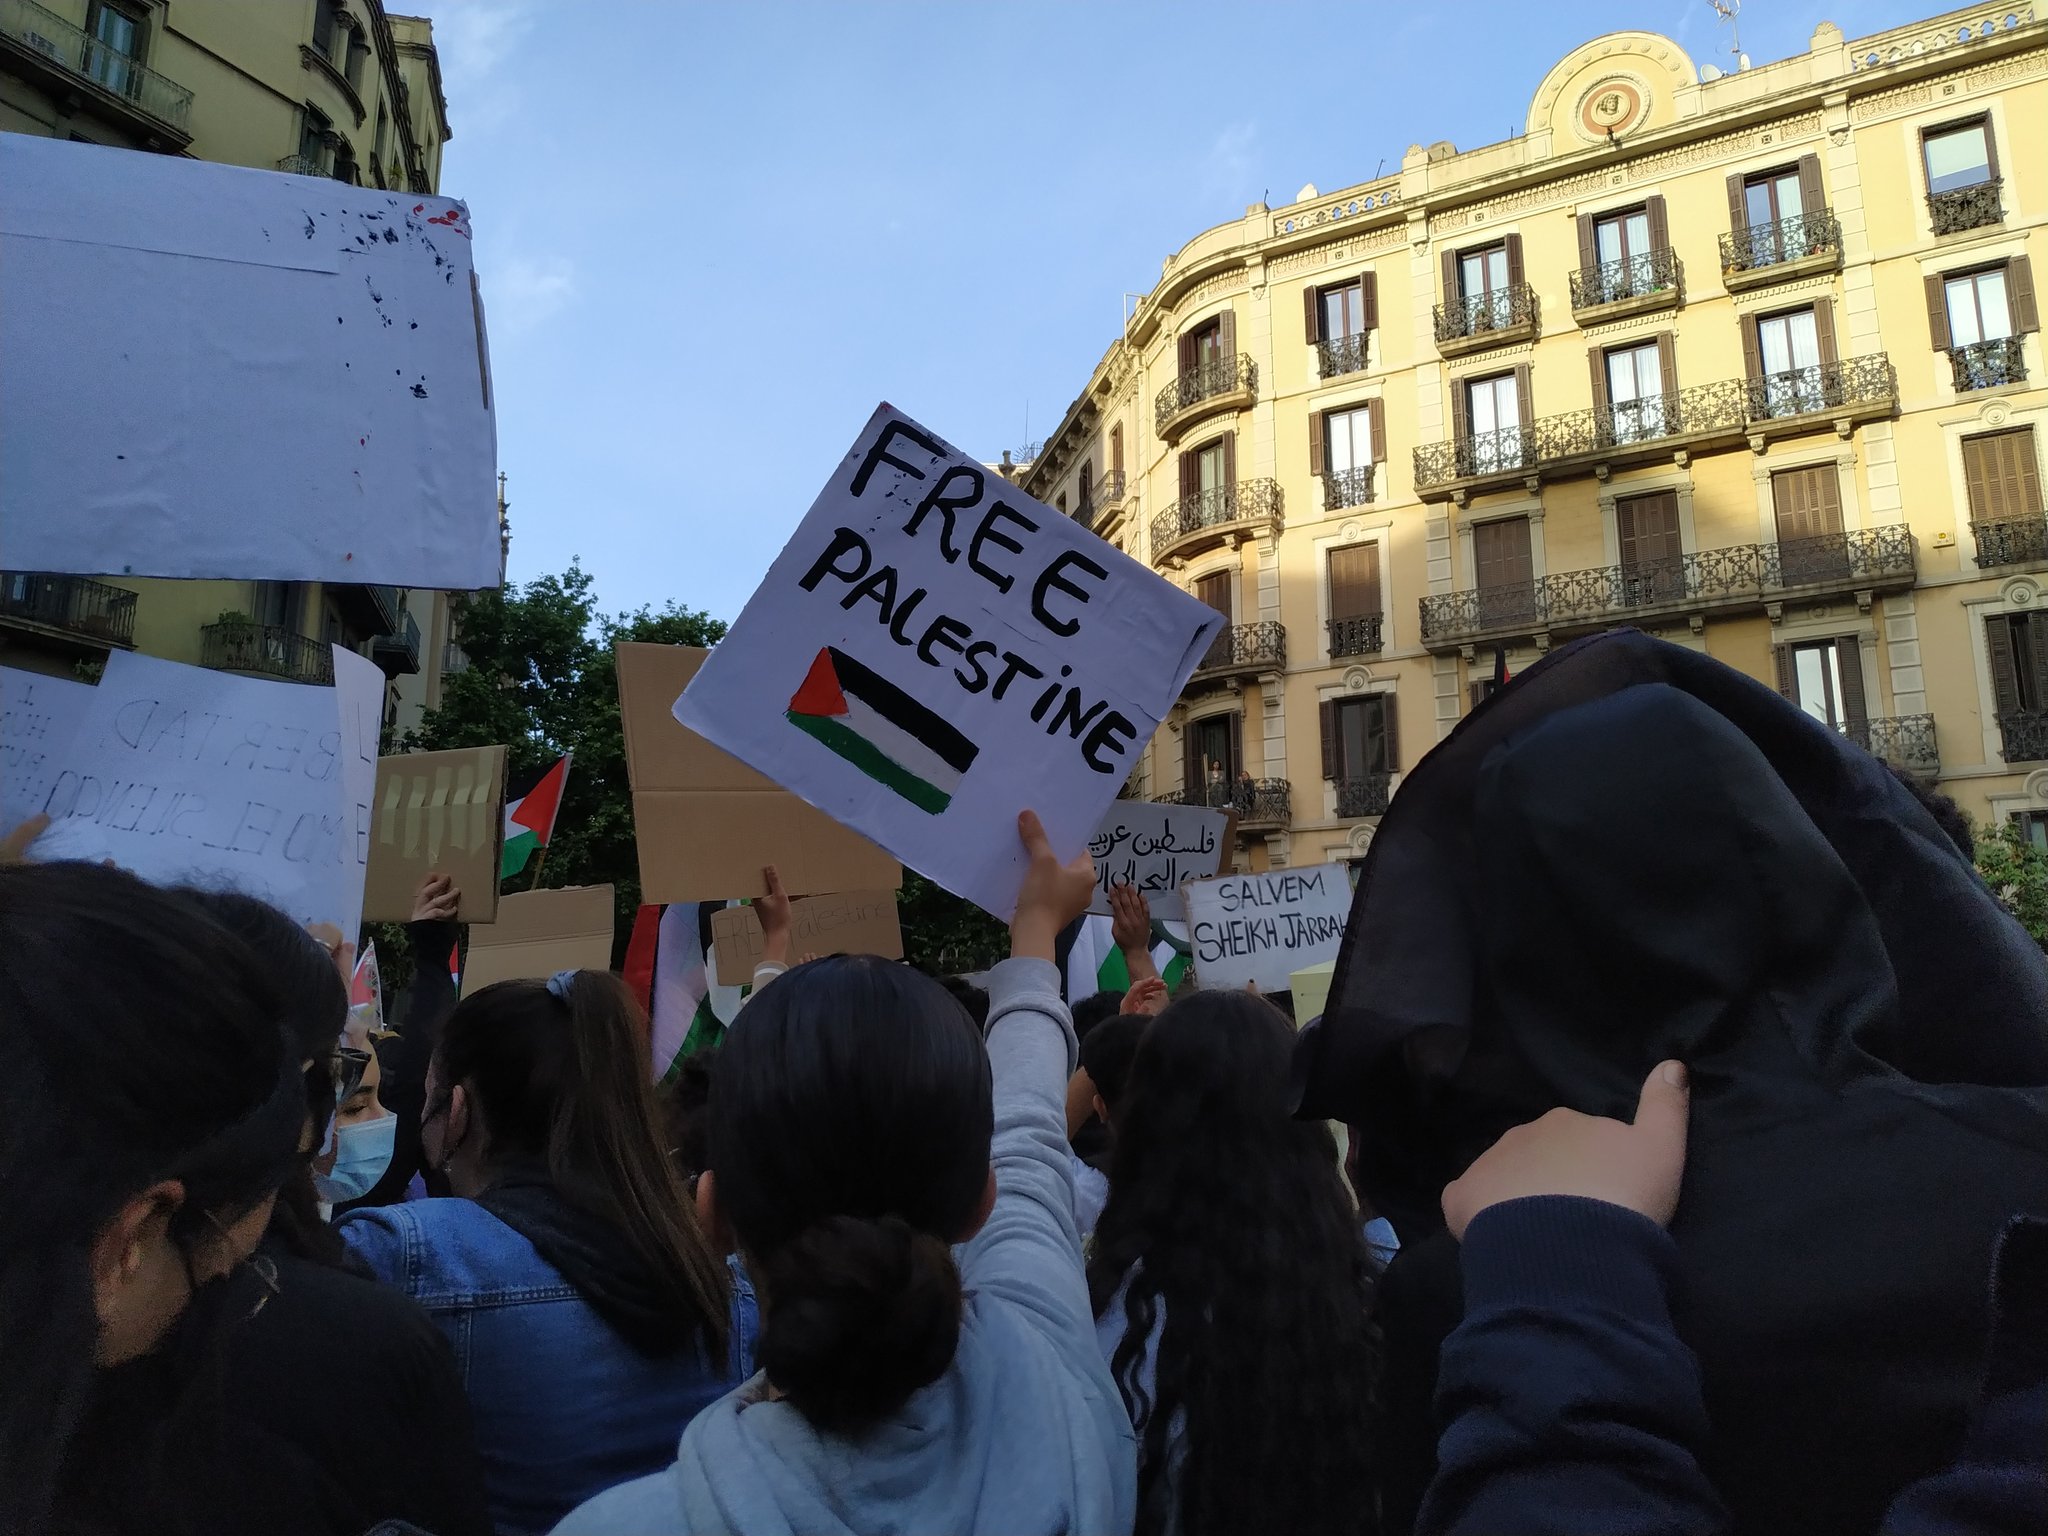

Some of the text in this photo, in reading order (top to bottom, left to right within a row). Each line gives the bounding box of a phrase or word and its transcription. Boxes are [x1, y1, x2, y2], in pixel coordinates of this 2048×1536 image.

[850, 420, 1109, 637] FREE
[1132, 818, 1215, 857] فلسطين
[1218, 871, 1326, 912] SALVEM
[714, 914, 768, 965] FRE
